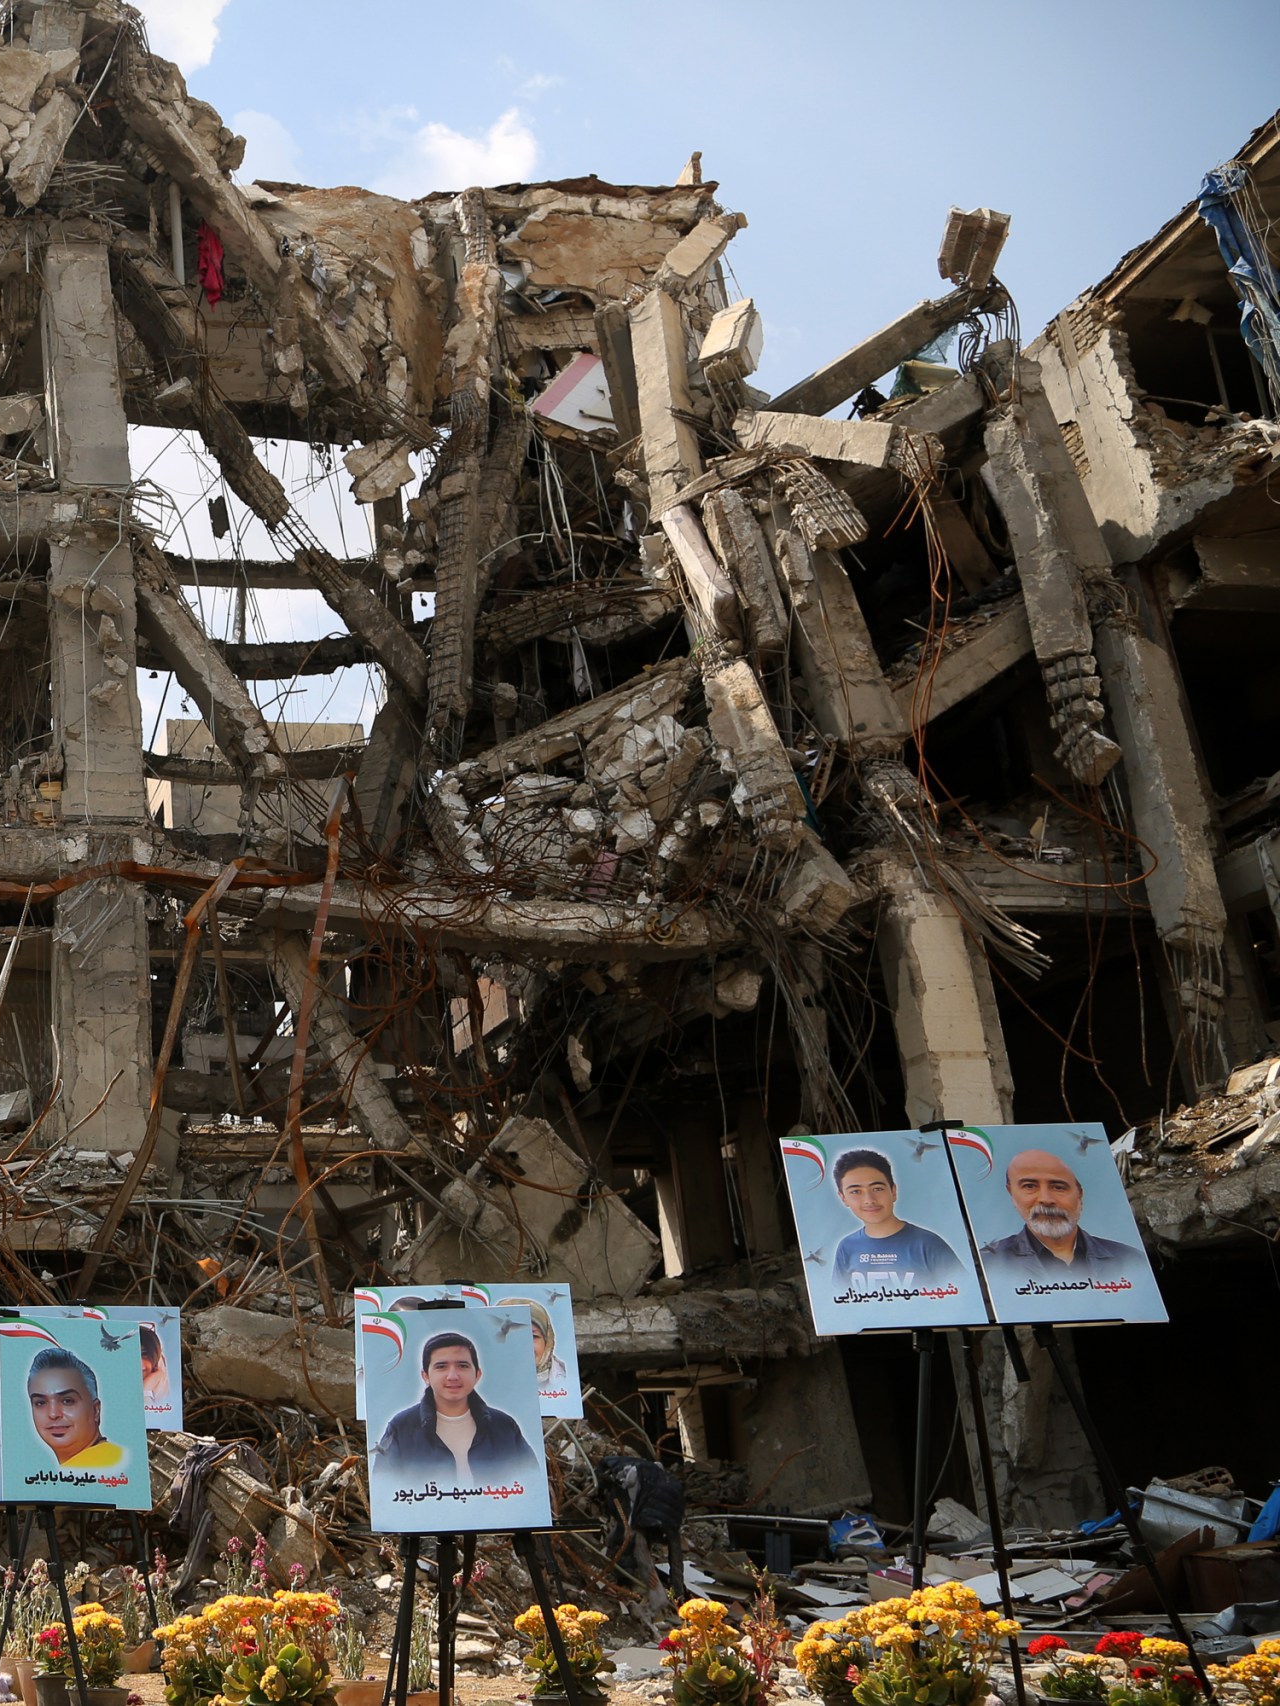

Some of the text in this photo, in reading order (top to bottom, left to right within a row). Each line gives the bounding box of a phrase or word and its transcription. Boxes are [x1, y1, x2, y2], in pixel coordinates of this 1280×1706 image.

[833, 1283, 958, 1304] شهید مهدیار میرزایی
[1015, 1277, 1131, 1295] شهید احمد میرزایی
[144, 1403, 172, 1413] شهیده
[24, 1470, 128, 1487] شهید علیرضا بابایی
[437, 1487, 483, 1503] سپهر
[483, 1481, 524, 1499] شهید
